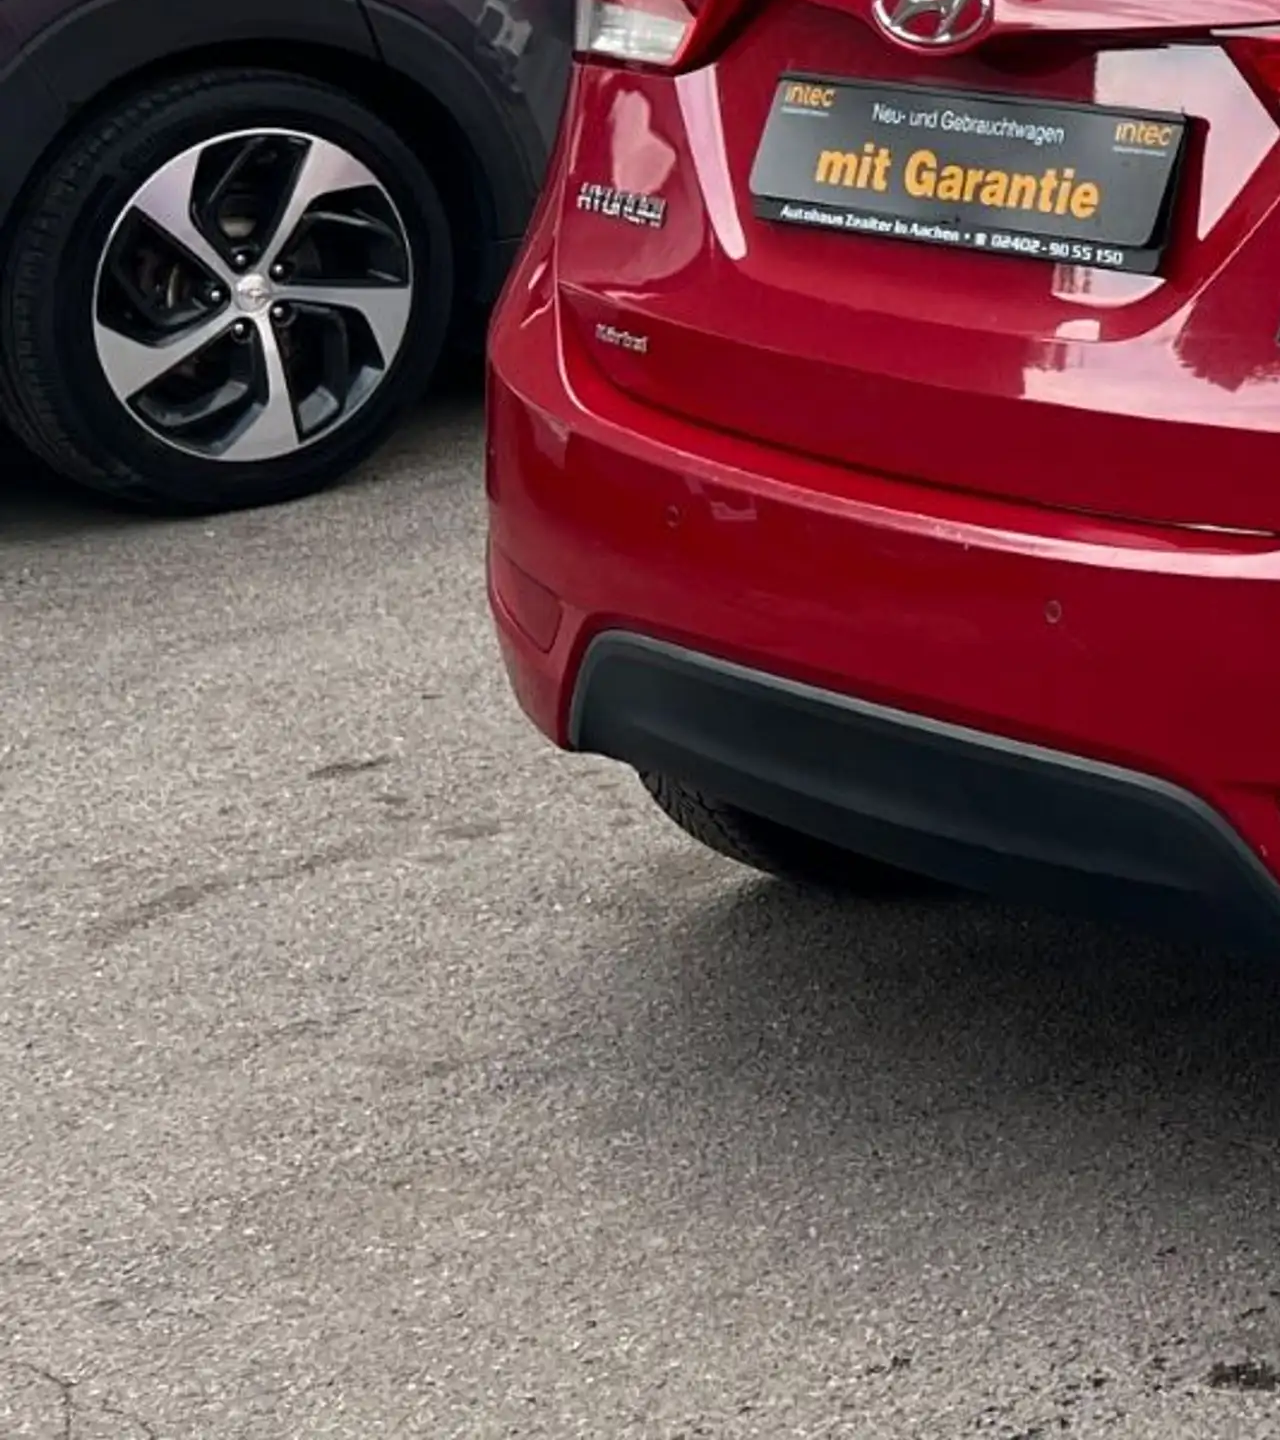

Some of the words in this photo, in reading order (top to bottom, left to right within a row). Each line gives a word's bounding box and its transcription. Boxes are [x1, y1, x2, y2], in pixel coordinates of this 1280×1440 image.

[872, 103, 905, 125] Neu-
[909, 108, 938, 129] und
[940, 110, 1065, 146] Gebrauchtwagen
[1115, 121, 1173, 147] intec
[814, 142, 891, 192] mit
[904, 149, 1099, 219] Garantie
